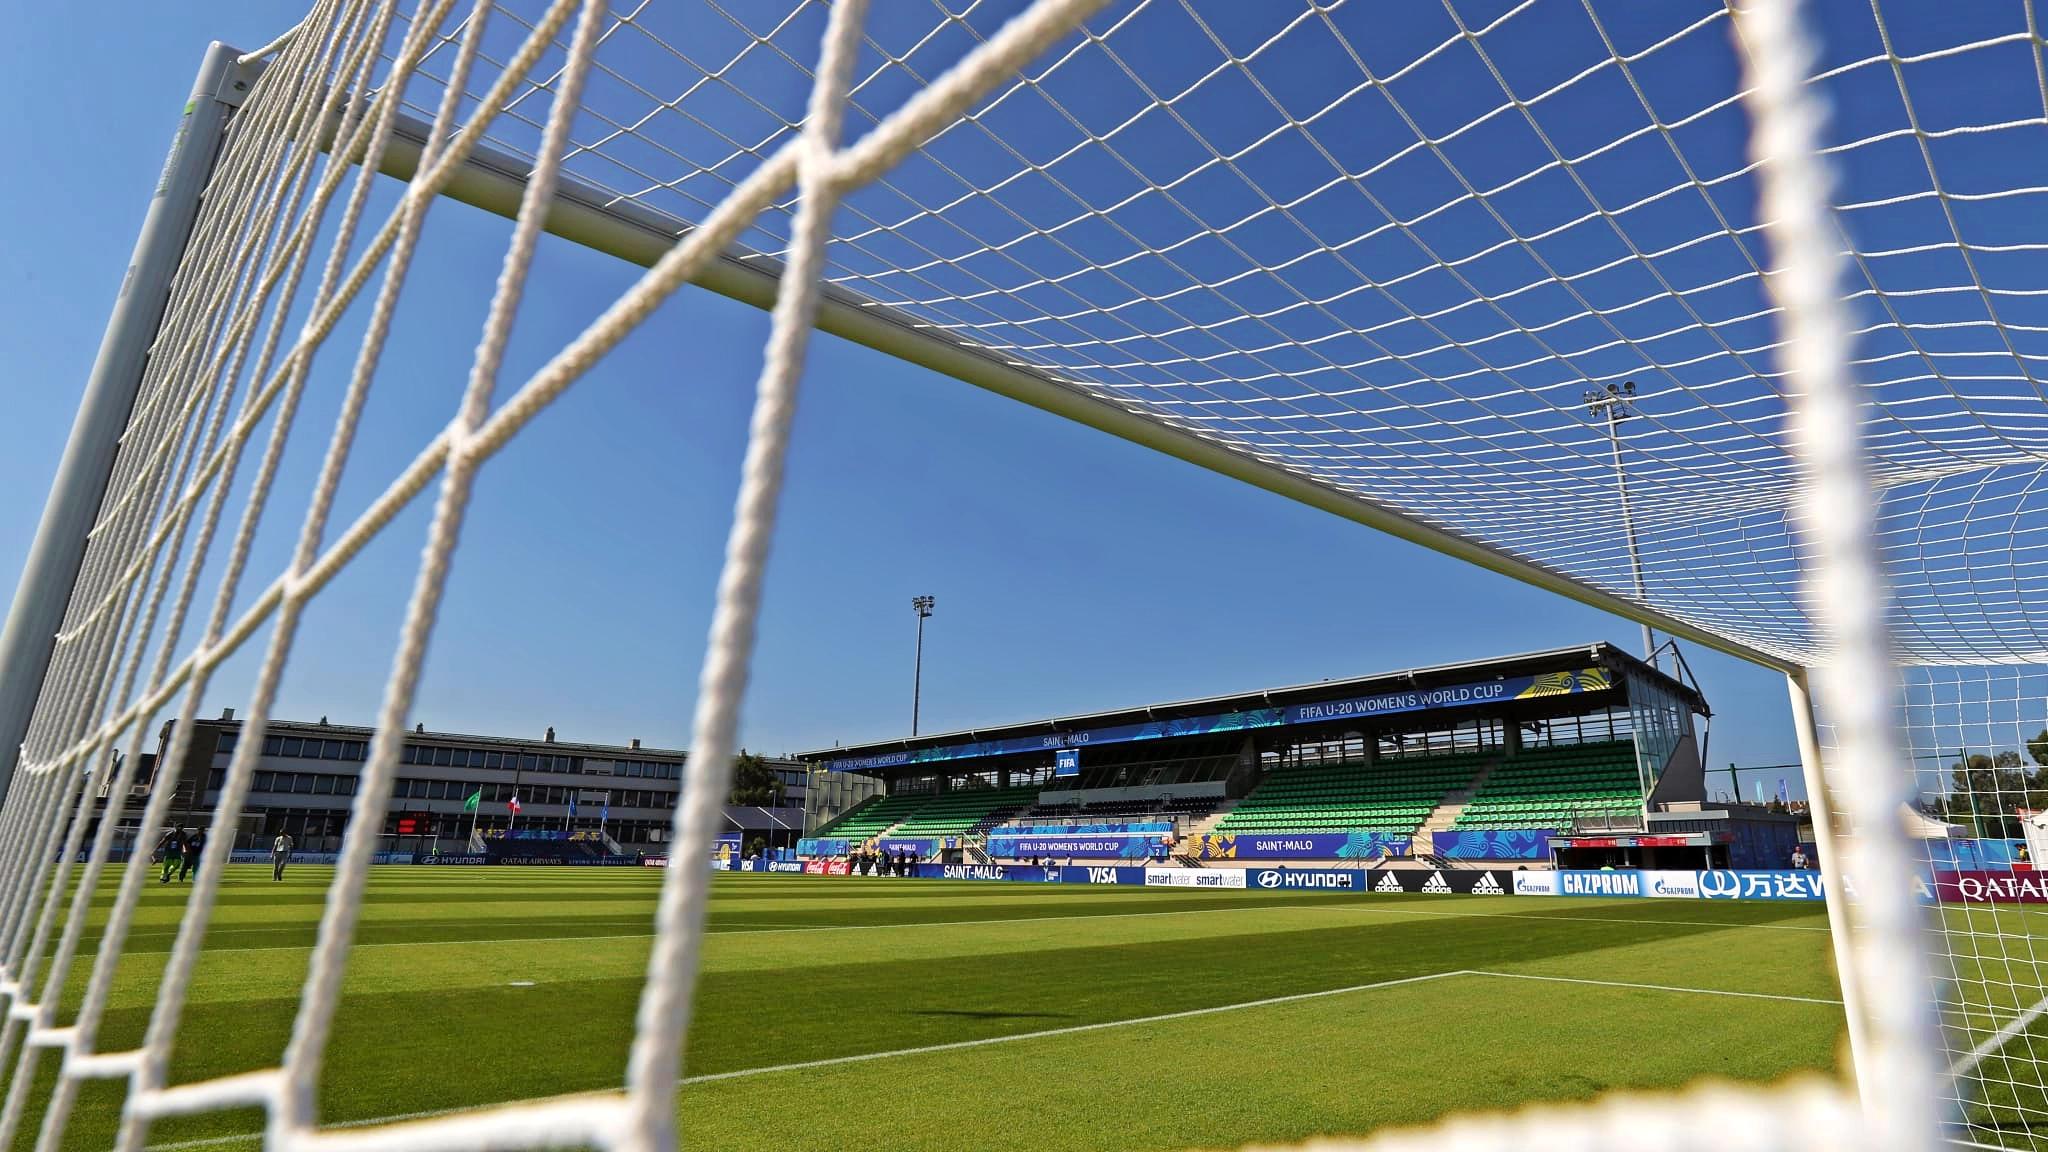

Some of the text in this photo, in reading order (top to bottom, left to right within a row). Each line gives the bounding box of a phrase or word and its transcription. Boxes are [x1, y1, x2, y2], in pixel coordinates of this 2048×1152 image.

[1300, 684, 1504, 719] FIFA U-20 WOMEN'S WORLD CUP
[1043, 733, 1089, 747] SAINT-MALO
[1059, 758, 1076, 769] FIFA
[1020, 842, 1119, 851] FIFA U-20 WOMEN'S WORLD CUP
[1256, 840, 1313, 851] SAINT-MALO
[440, 856, 486, 865] HYUNDAI
[501, 857, 527, 865] QATAR
[741, 861, 754, 872] VISA
[777, 863, 802, 872] HYUNDAI
[944, 865, 1004, 880] SAINT-MALO
[1087, 867, 1118, 884] VISA
[1147, 873, 1191, 885] smartwater
[1196, 874, 1243, 886] smartwater
[1285, 873, 1353, 888] HYUNDAI
[1563, 873, 1639, 895] GAZPROM
[1375, 884, 1403, 893] adidas
[1421, 885, 1452, 894] adidas
[1471, 886, 1505, 895] adidas
[1526, 885, 1550, 893] GAZPROM
[1666, 887, 1694, 895] GAZPROM
[1741, 873, 1808, 898] 万达
